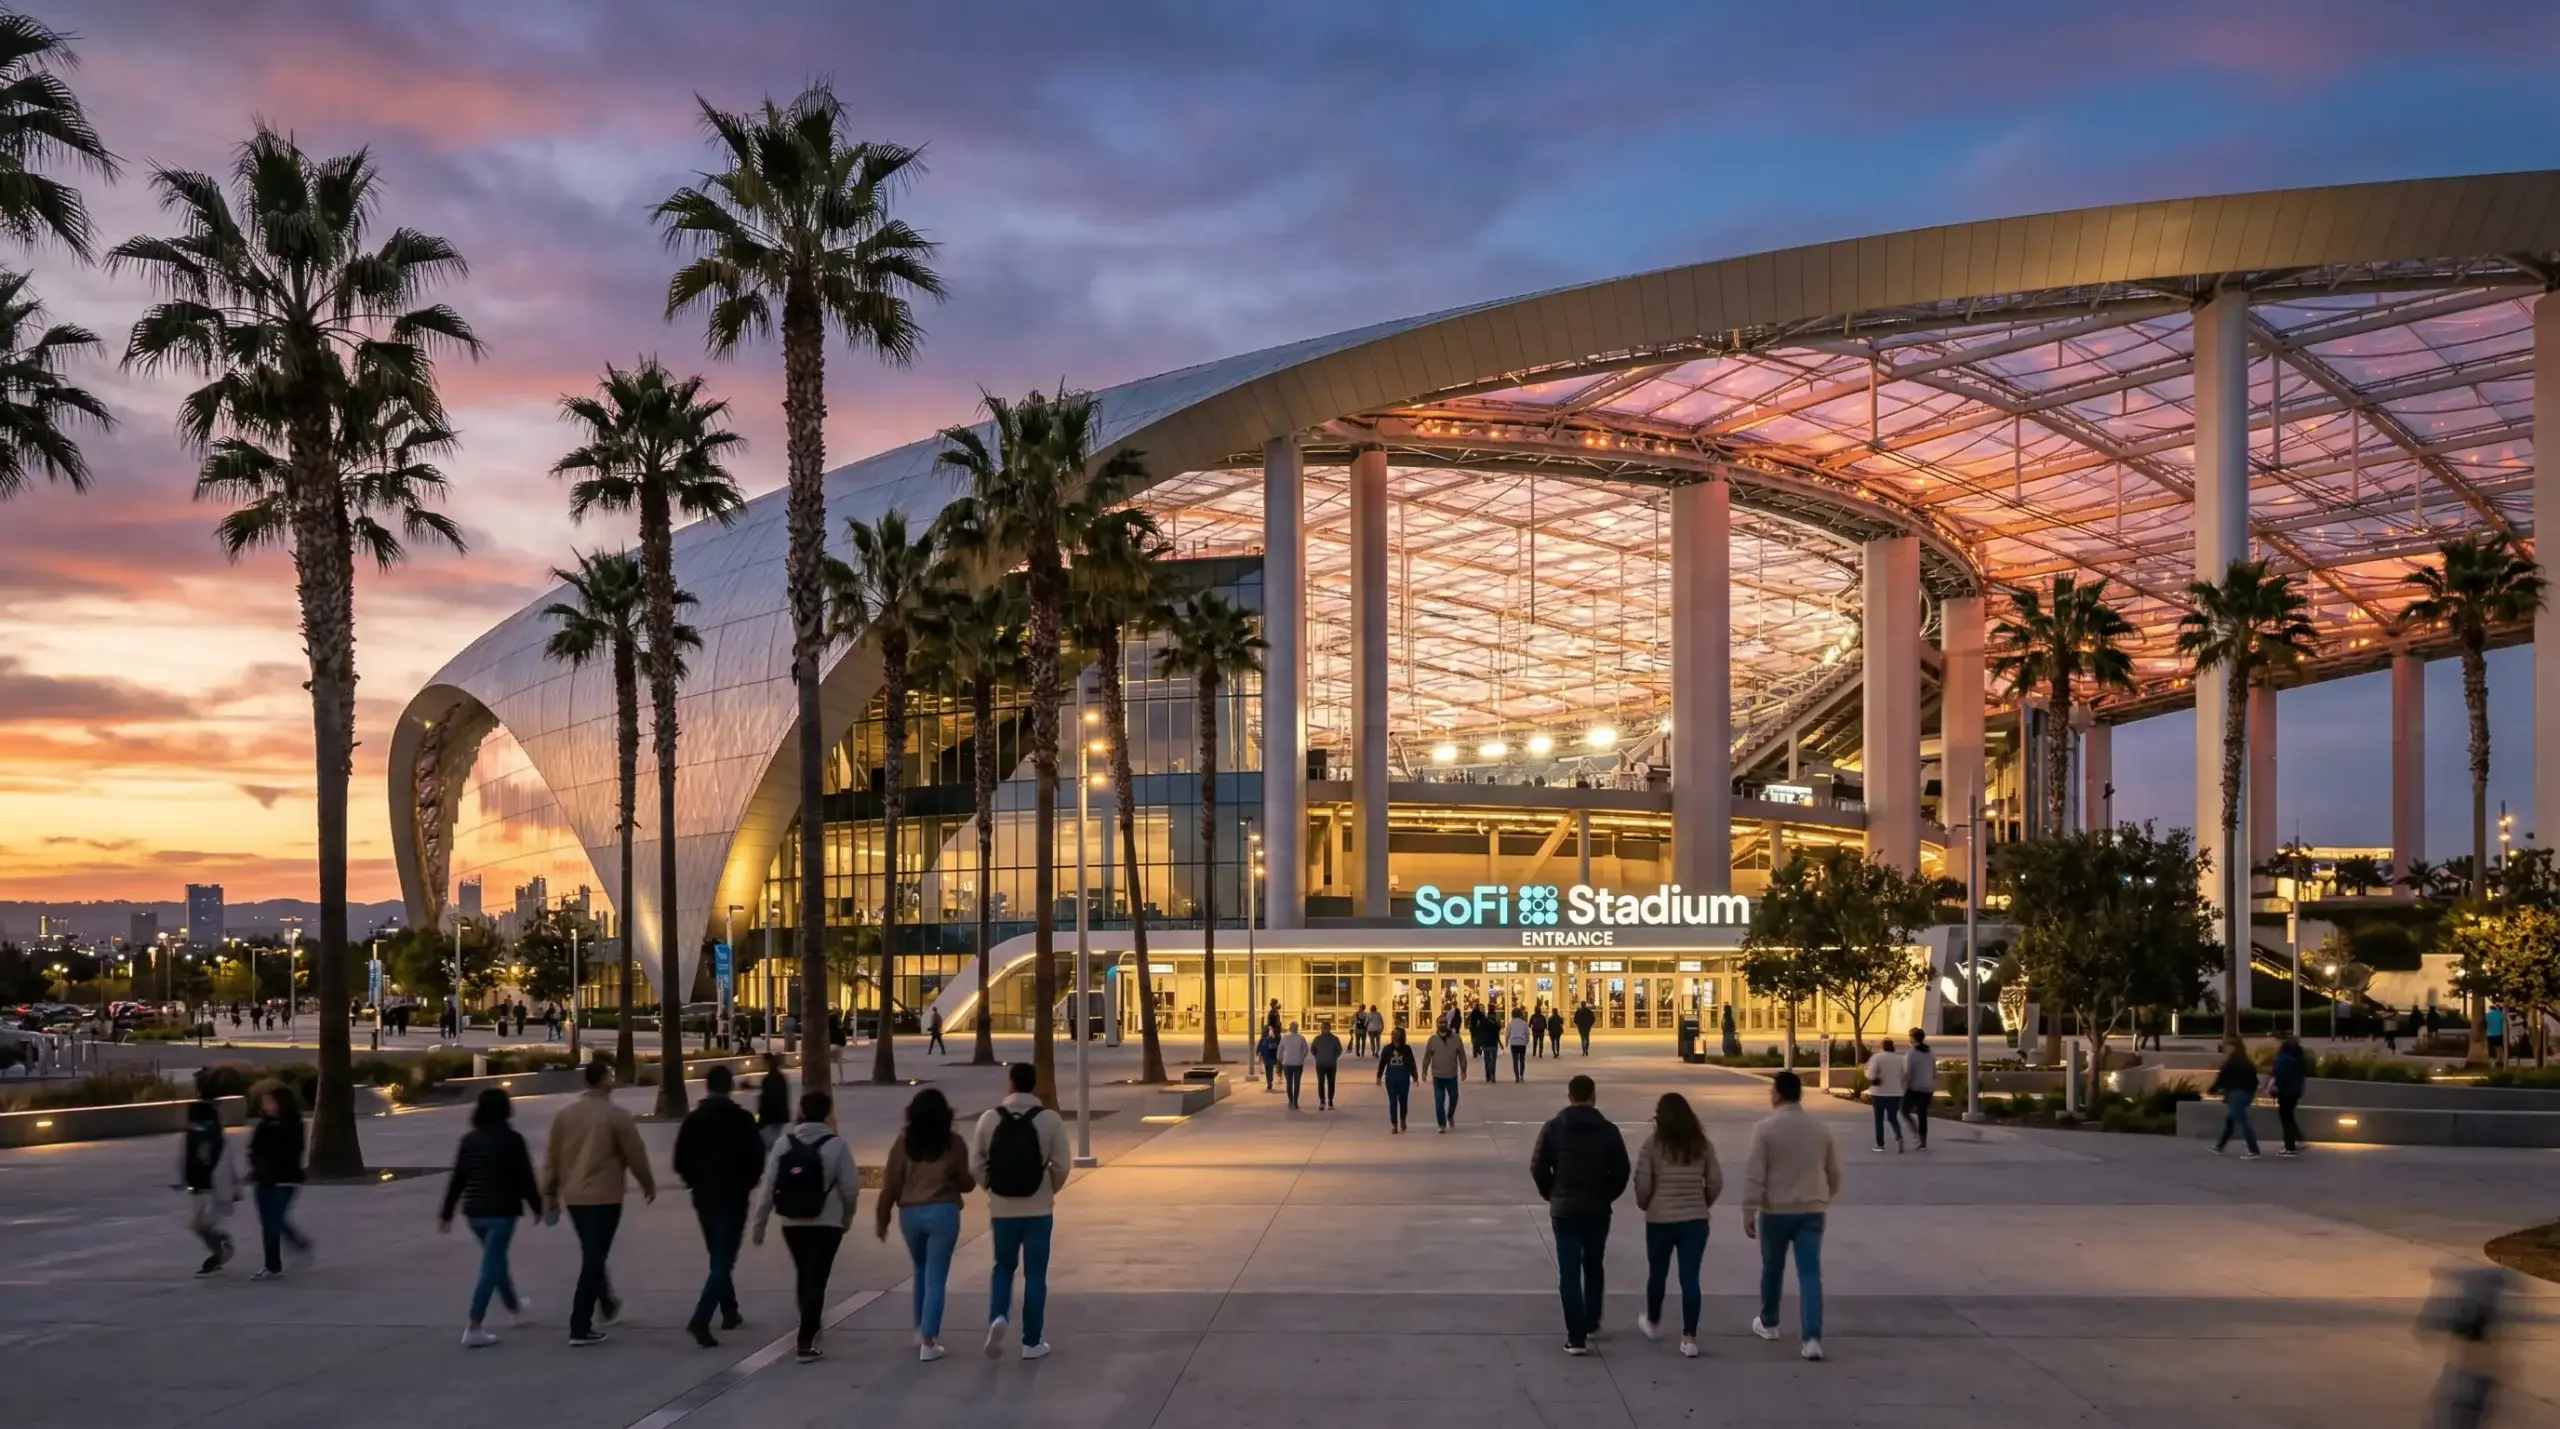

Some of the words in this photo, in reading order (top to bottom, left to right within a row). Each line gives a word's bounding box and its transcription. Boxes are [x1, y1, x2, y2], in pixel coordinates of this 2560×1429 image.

[1414, 884, 1509, 925] SoFi
[1567, 884, 1750, 925] Stadium
[1522, 931, 1614, 946] ENTRANCE
